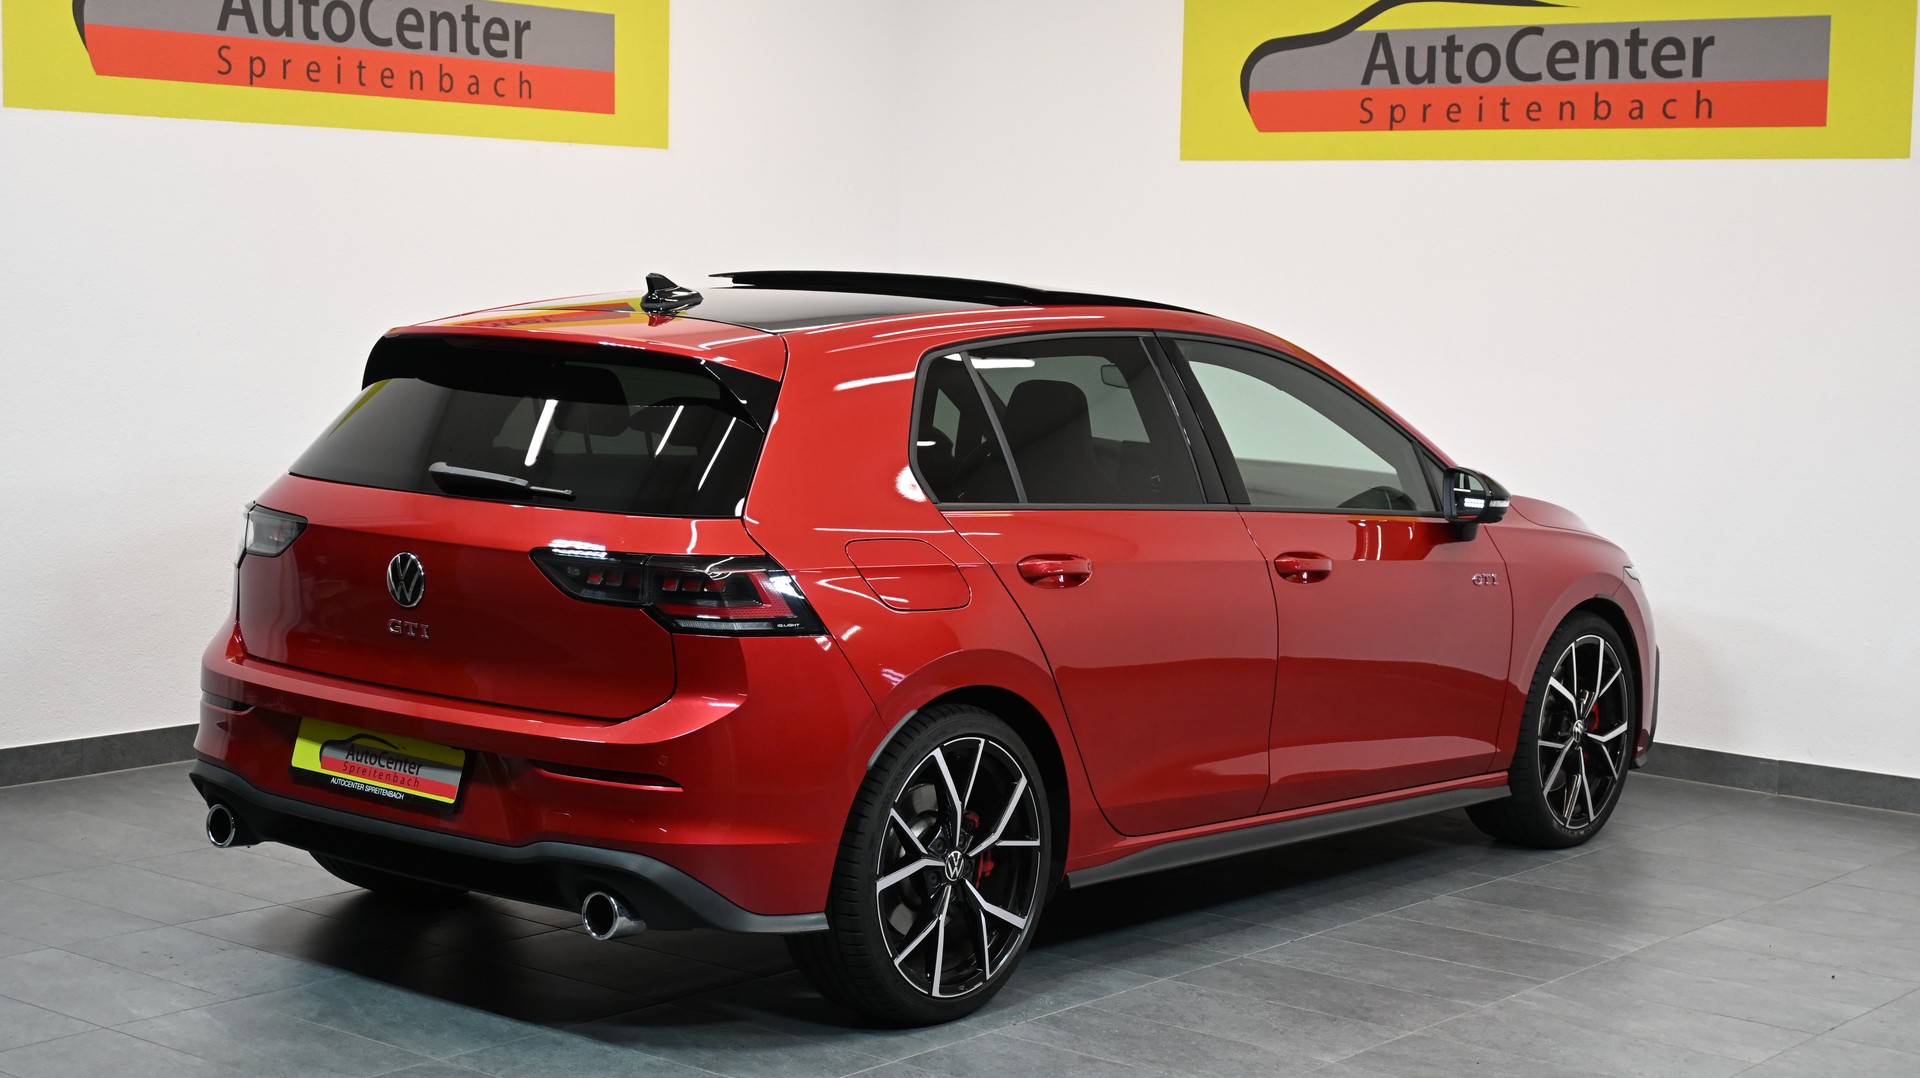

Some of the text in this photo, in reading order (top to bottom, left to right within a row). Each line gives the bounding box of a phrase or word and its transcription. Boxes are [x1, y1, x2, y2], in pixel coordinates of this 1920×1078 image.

[216, 0, 531, 60] AutoCenter
[216, 44, 533, 100] Spreitenbach
[1360, 26, 1716, 86] AutoCenter
[1359, 89, 1714, 131] Spreitenbach
[1471, 572, 1499, 587] GTI
[388, 618, 429, 639] GTI
[342, 760, 420, 788] Spreitenbach
[345, 743, 423, 776] AutoCenter
[330, 777, 405, 800] AUTOCENTER SPREITENBACH
